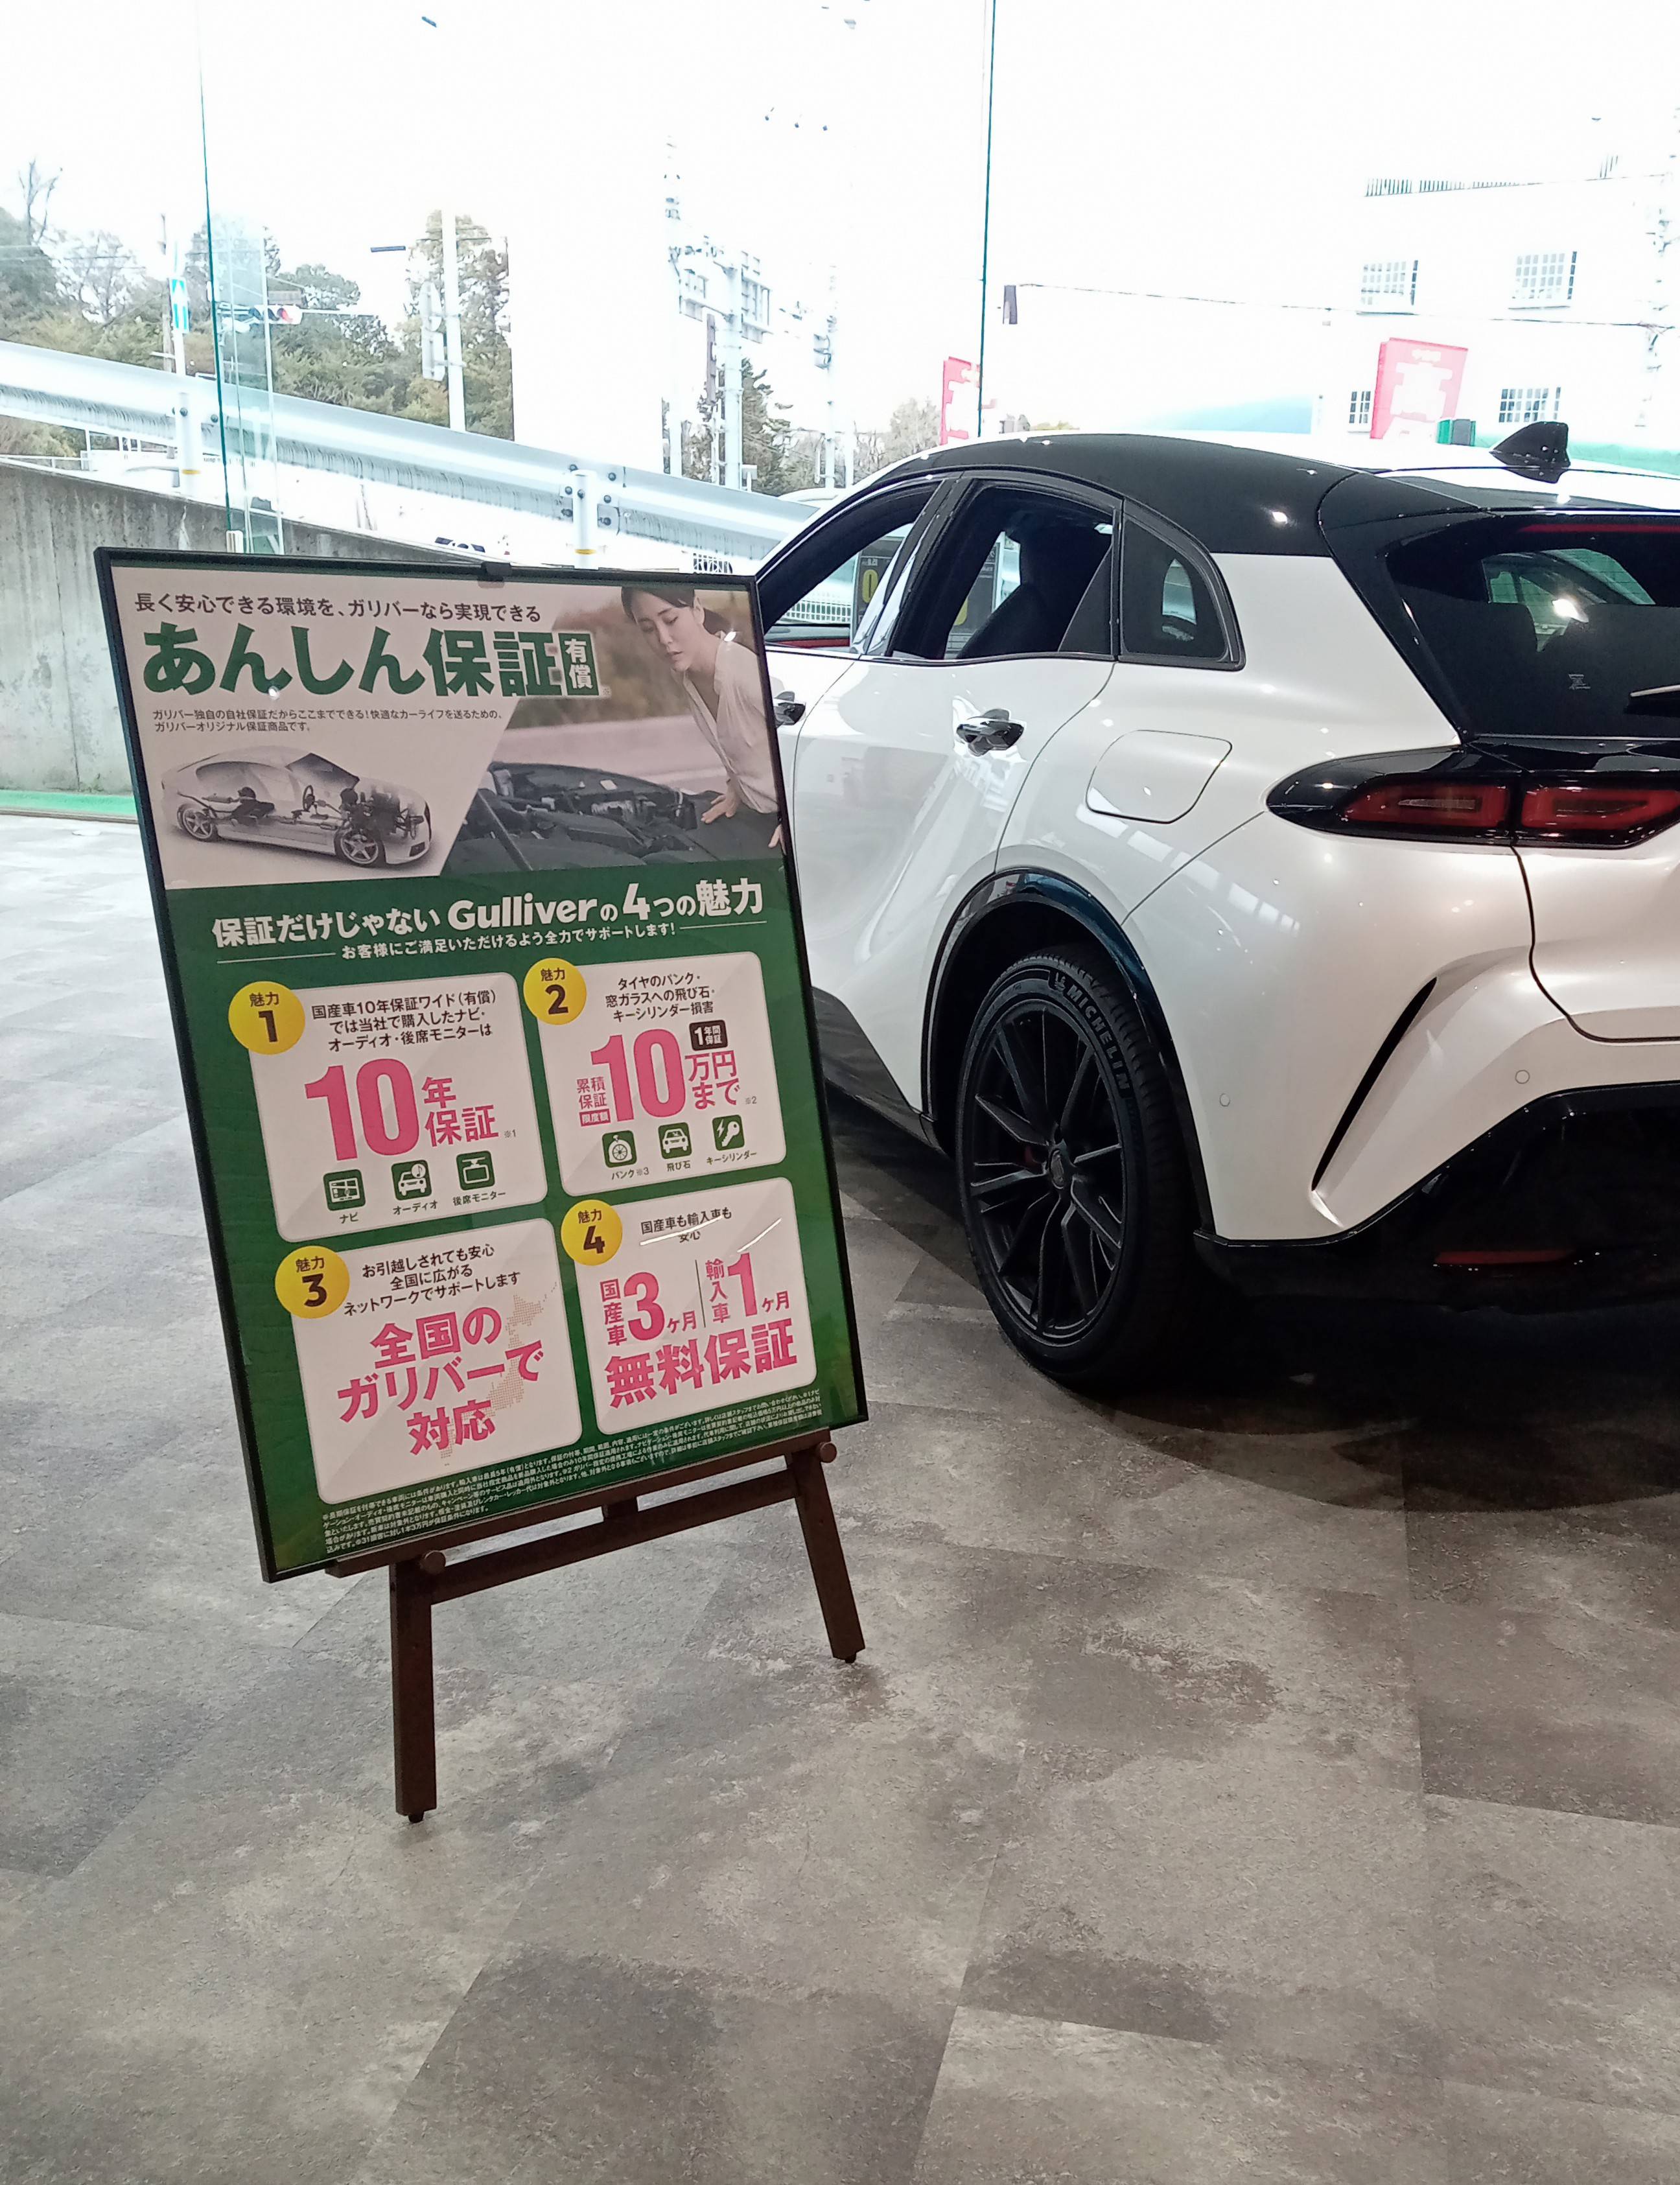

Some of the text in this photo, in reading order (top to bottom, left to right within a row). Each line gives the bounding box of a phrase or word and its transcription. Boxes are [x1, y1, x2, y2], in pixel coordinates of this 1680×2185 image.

[135, 592, 541, 623] 長く安心できる環境を、ガリバーなら実現できる
[143, 621, 593, 697] あんしん保証 有償
[541, 968, 566, 982] 魅力
[249, 992, 279, 1007] 魅力
[544, 984, 569, 1016] 2
[612, 1000, 714, 1023] キーシリンダー損害
[257, 1010, 279, 1043] 1
[1067, 983, 1130, 1090] MICHELIN
[692, 1078, 741, 1110] まで
[425, 1104, 499, 1147] 保証
[666, 1160, 691, 1172] 飛び石
[706, 1150, 757, 1165] キーシリンダー
[392, 1200, 438, 1216] オーディオ
[452, 1190, 506, 1208] 後席モニター
[339, 1212, 359, 1224] ナビ
[578, 1209, 603, 1224] 魅力
[640, 1207, 732, 1235] 国産車も輸入車も
[583, 1225, 605, 1254] 4
[295, 1256, 325, 1273] 魅力
[362, 1243, 495, 1278] お引越しされても安心
[301, 1273, 328, 1307] 3
[343, 1271, 521, 1317] ネットワークでサポートします
[390, 1264, 473, 1292] 全国に広がる
[705, 1257, 730, 1324] 輸入車
[600, 1278, 627, 1346] 国産車
[370, 1307, 502, 1370] 全国の
[605, 1318, 798, 1409] 無料保証
[337, 1340, 544, 1423] ガリバーで
[407, 1399, 496, 1456] 対応
